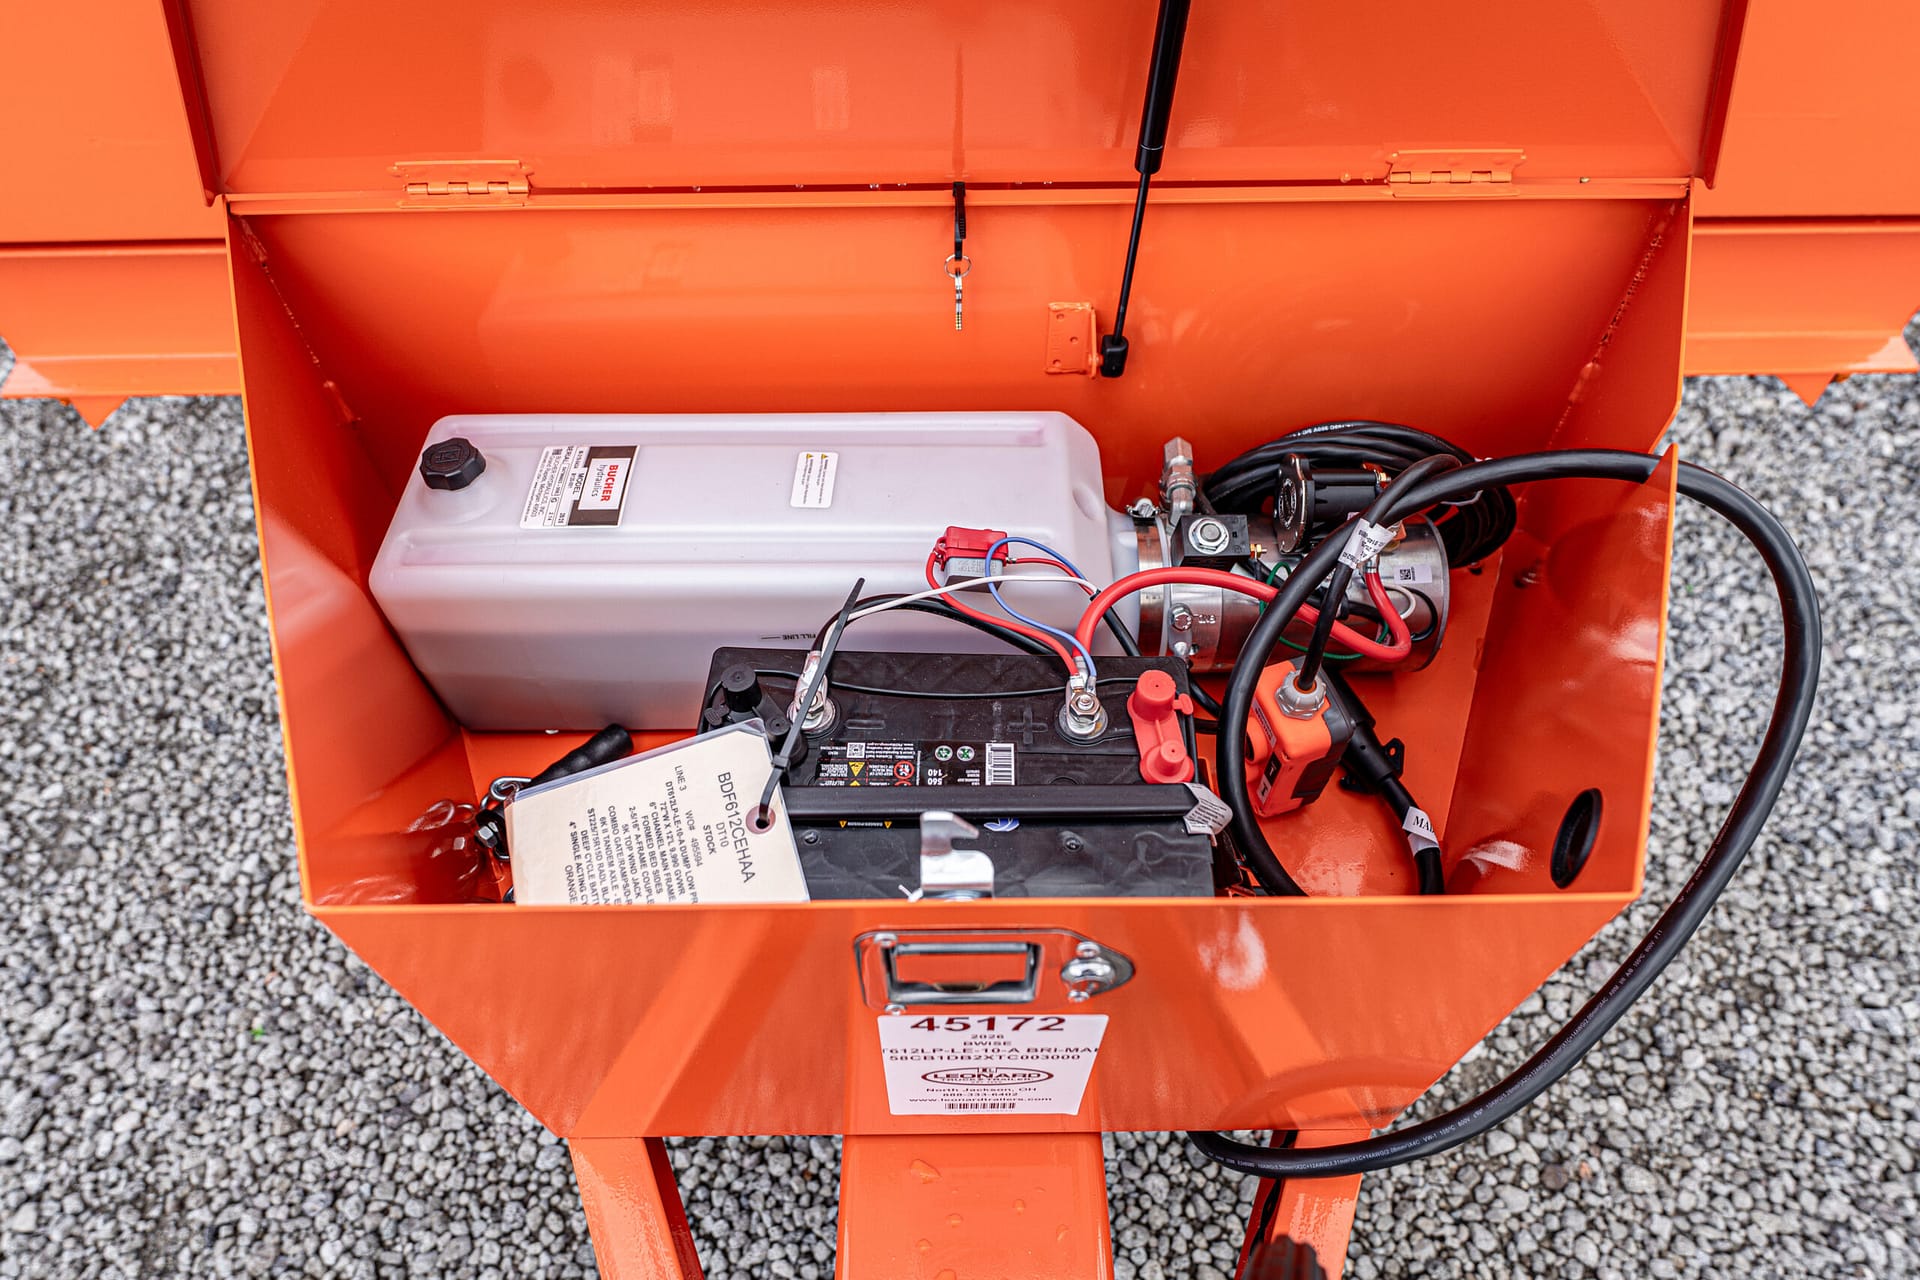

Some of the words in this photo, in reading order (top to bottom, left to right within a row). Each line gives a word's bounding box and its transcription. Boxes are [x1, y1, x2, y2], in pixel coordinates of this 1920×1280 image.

[572, 472, 584, 494] MODEL
[592, 464, 607, 496] hydraulics
[601, 464, 619, 502] BUCHER
[928, 778, 942, 786] 560
[600, 817, 607, 827] 6K
[608, 806, 619, 835] COMBO
[666, 781, 685, 845] DT612LP-LE-10-A
[675, 765, 685, 784] LINE
[685, 810, 695, 830] WO#
[691, 838, 703, 867] 495594
[581, 830, 590, 851] DEEP
[622, 824, 629, 834] 5K
[629, 806, 640, 831] 2-5/16"
[635, 834, 647, 869] A-FRAME
[641, 815, 654, 849] FORMED
[651, 812, 664, 849] CHANNEL
[703, 825, 716, 854] STOCK
[716, 822, 729, 847] DT10
[718, 772, 755, 883] BDF612CEHAA
[588, 808, 602, 861] ST225/75R15D
[597, 863, 606, 885] RADL
[603, 835, 614, 867] TANDEM
[625, 835, 633, 851] TOP
[571, 831, 581, 860] SINGLE
[576, 863, 586, 892] ACTING
[584, 853, 595, 880] CYCLE
[628, 853, 637, 874] WIND
[649, 851, 657, 867] BED
[660, 851, 669, 871] MAIN
[680, 846, 691, 869] DUMP
[565, 865, 577, 904] ORANGE
[609, 870, 619, 890] AXLE
[632, 878, 642, 899] JACK
[652, 869, 663, 894] SIDES
[664, 872, 675, 901] FRAME
[674, 869, 685, 895] GVWR
[685, 871, 695, 889] LOW
[910, 1016, 1066, 1031] 45172
